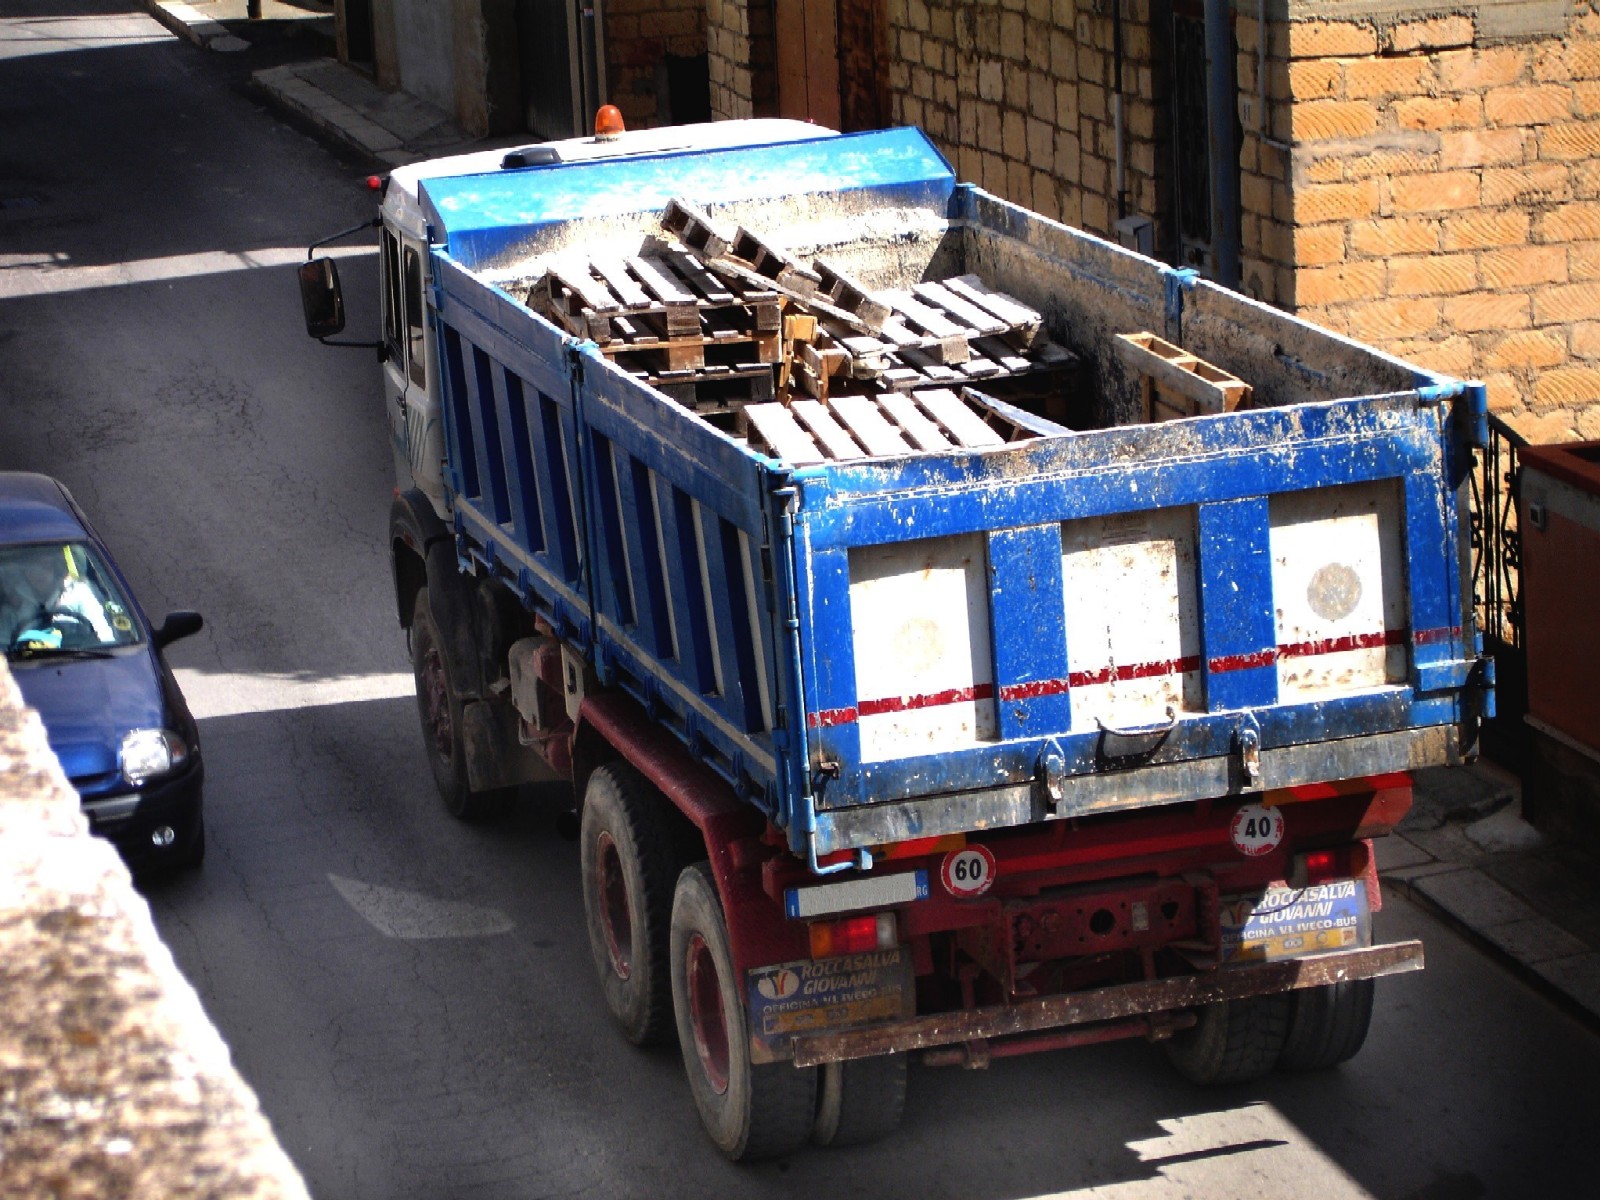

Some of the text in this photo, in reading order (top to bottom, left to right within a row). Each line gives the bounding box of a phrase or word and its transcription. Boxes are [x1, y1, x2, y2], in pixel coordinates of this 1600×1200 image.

[1245, 816, 1271, 838] 40
[955, 858, 982, 881] 60
[916, 885, 928, 897] RG
[1256, 884, 1356, 909] ROCCASALVA
[1259, 901, 1334, 924] GIOVANNI
[1297, 916, 1358, 931] IVECO-BUS
[801, 950, 901, 979] ROCCASALVA
[803, 971, 877, 995] GIOVANNI
[763, 998, 819, 1015] OFFICINA
